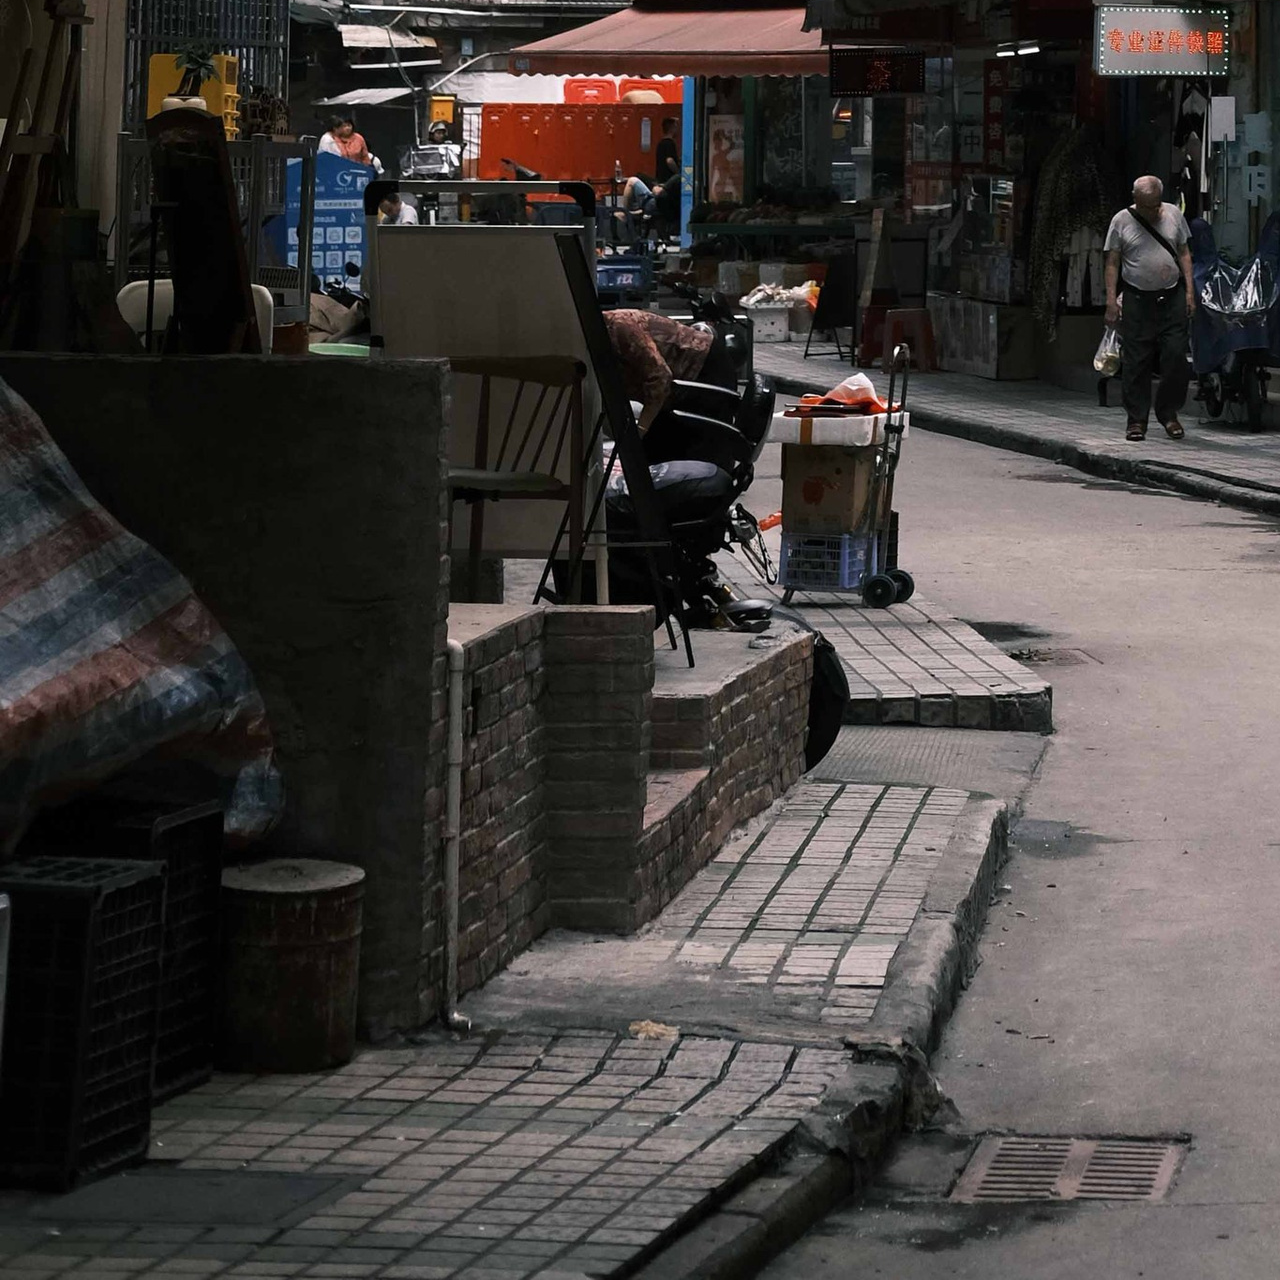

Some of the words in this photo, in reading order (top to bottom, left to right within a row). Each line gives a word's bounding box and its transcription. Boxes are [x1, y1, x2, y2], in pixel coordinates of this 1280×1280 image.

[1107, 28, 1223, 55] 专业证件快照
